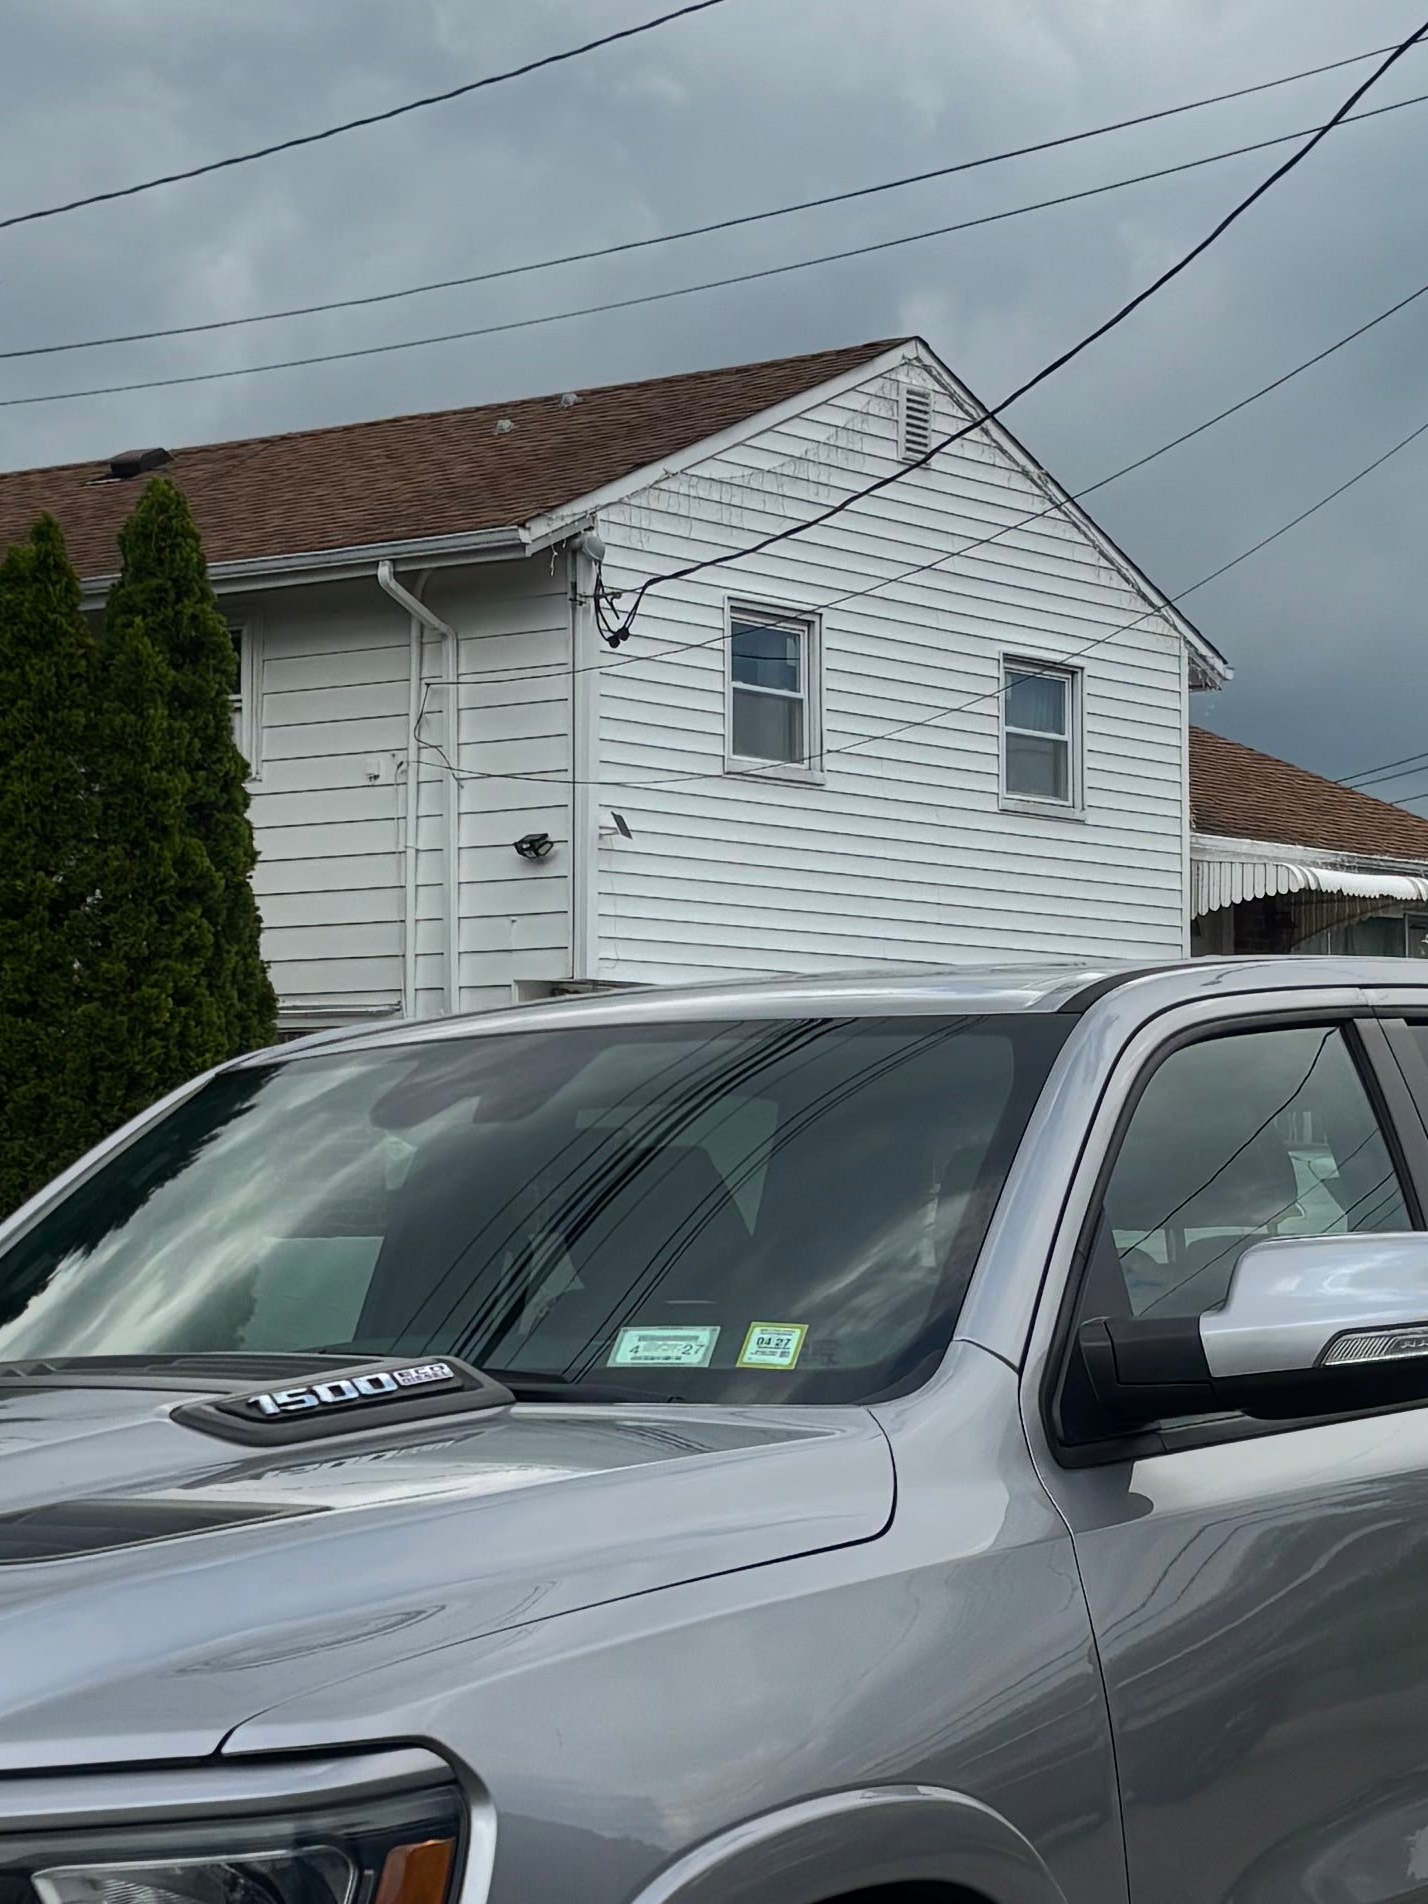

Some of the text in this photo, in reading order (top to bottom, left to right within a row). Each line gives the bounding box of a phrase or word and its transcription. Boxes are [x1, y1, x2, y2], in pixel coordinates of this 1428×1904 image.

[756, 1336, 791, 1349] 04 27
[681, 1344, 705, 1356] 27
[397, 1364, 445, 1378] ECO
[247, 1371, 399, 1416] 1500
